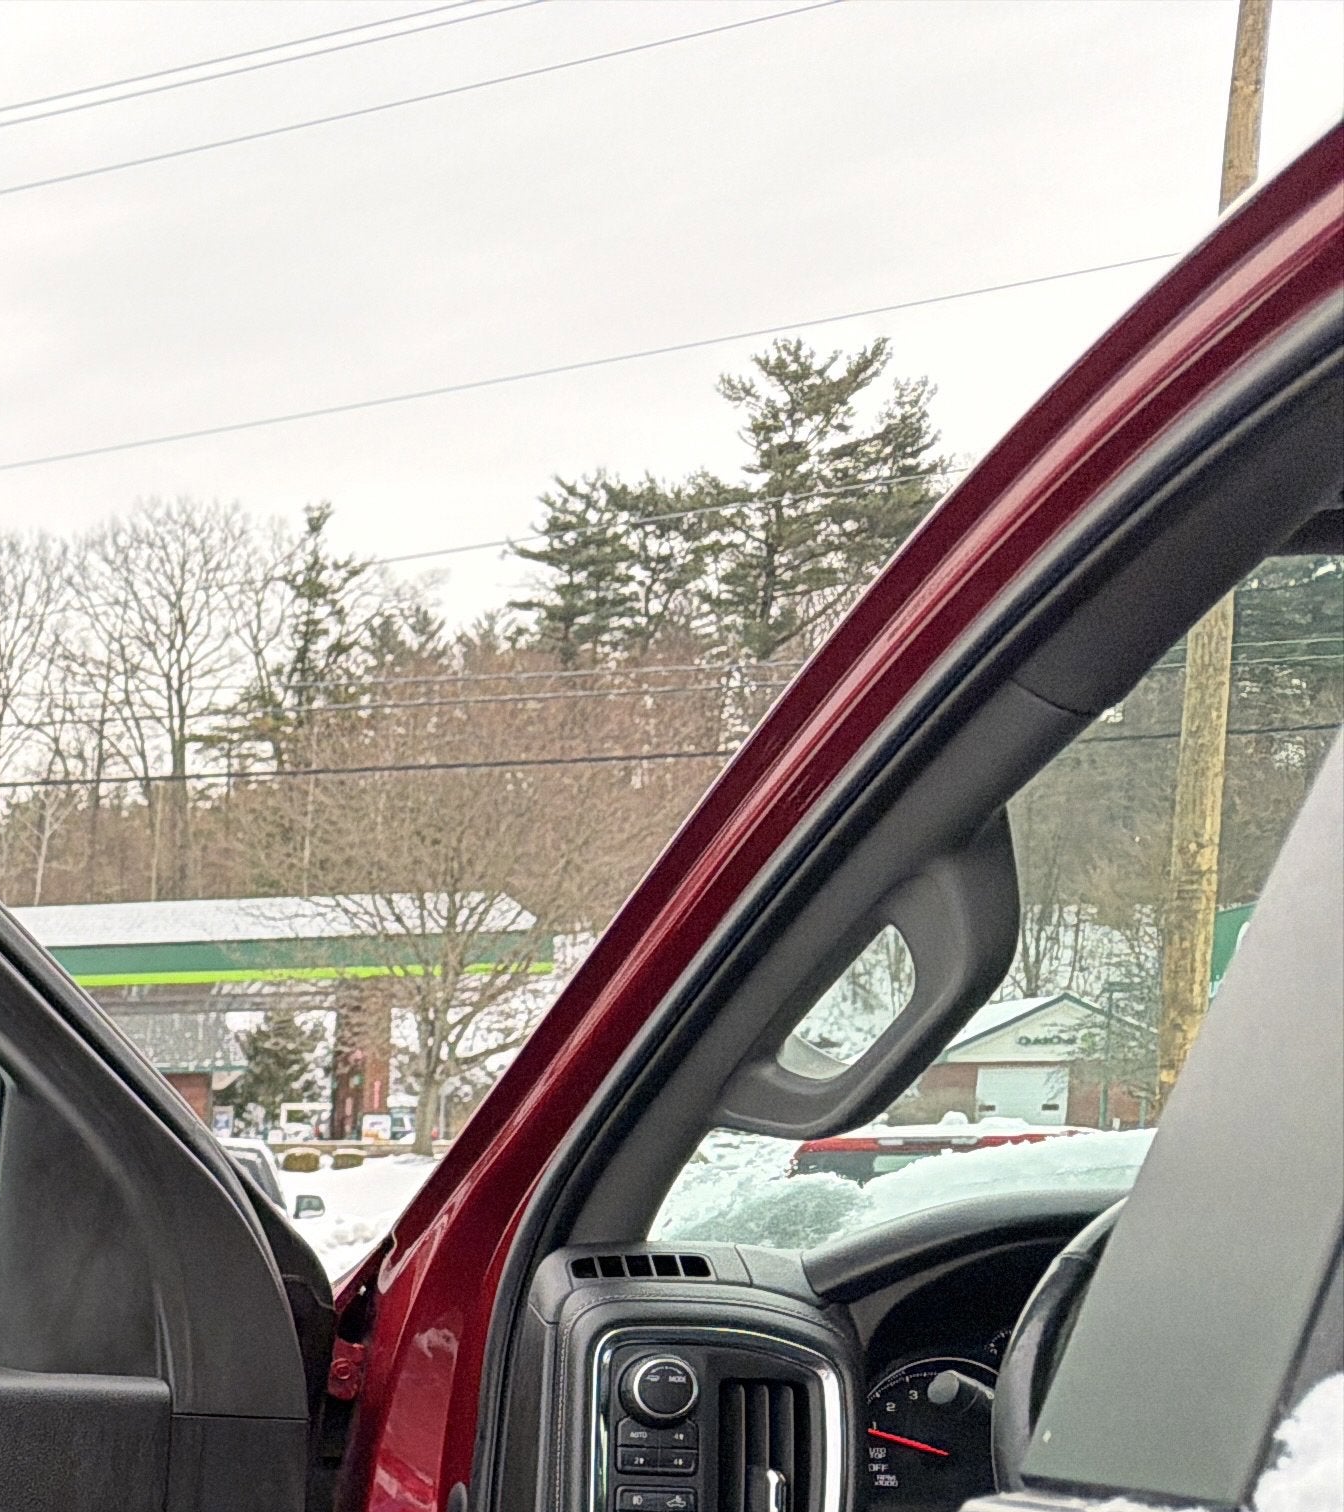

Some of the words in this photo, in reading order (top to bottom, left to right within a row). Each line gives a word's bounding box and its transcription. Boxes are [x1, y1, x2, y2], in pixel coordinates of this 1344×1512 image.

[908, 1389, 919, 1401] 3
[885, 1401, 897, 1412] 2
[629, 1431, 648, 1439] AUTO
